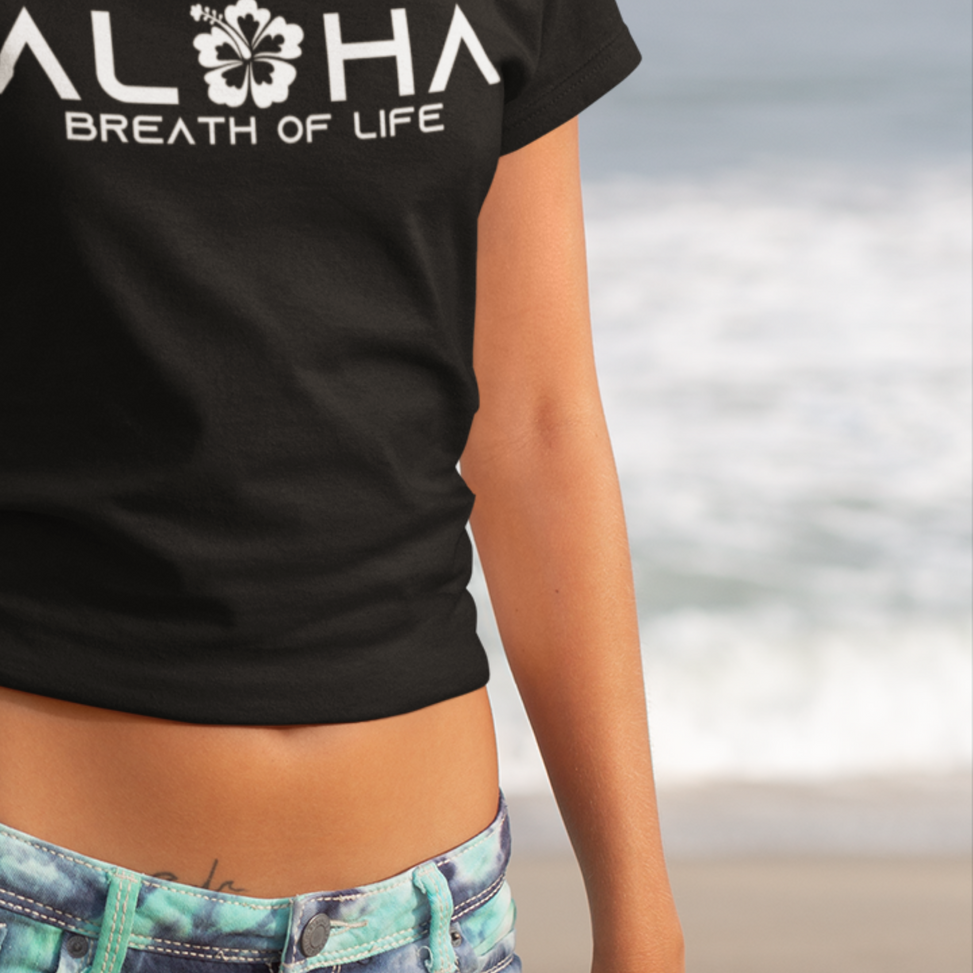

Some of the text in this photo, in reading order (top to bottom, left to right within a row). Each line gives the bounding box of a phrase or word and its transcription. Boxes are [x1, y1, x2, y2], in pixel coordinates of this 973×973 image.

[64, 102, 445, 146] BREATH OF LIFE
